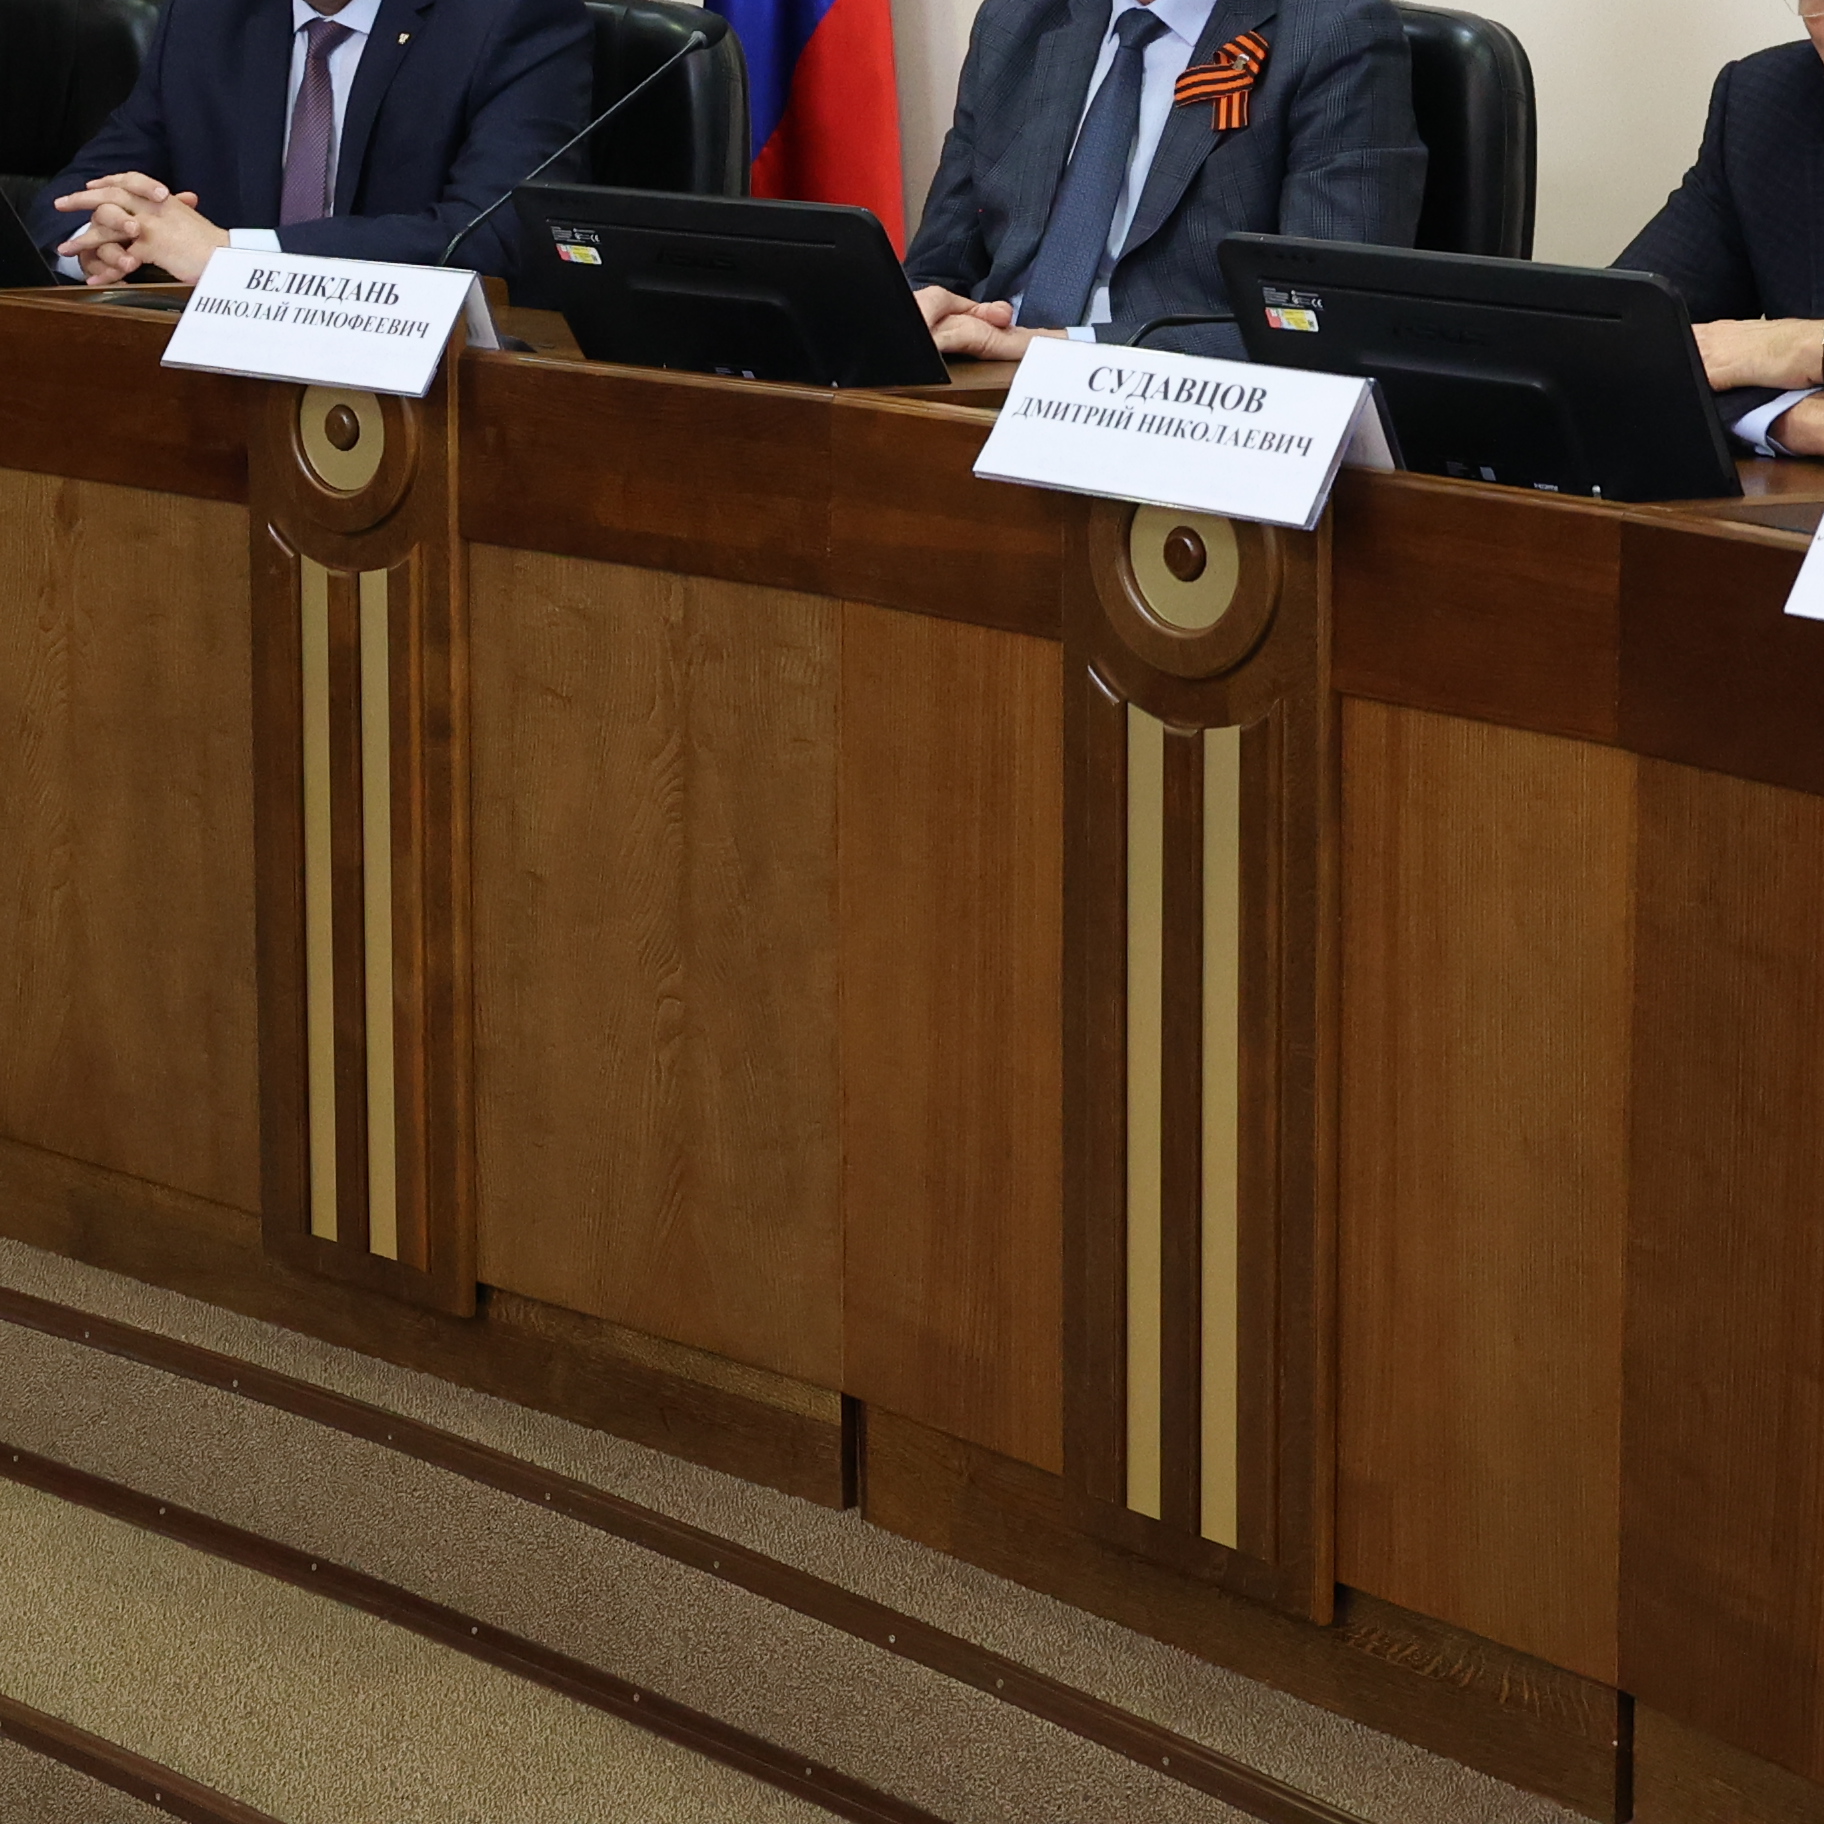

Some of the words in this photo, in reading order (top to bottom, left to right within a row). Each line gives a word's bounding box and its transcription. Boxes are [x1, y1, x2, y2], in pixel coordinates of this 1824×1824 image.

[244, 268, 400, 306] ВЕЛИКДАНЬ
[193, 295, 290, 322] НИКОЛАЙ
[291, 306, 430, 339] ТИМОФЕЕВИЧ
[1087, 365, 1268, 414] СУДАВЦОВ
[1012, 396, 1136, 430] ДМИТРИЙ
[1136, 412, 1315, 457] НИКОЛАЕВИЧ
